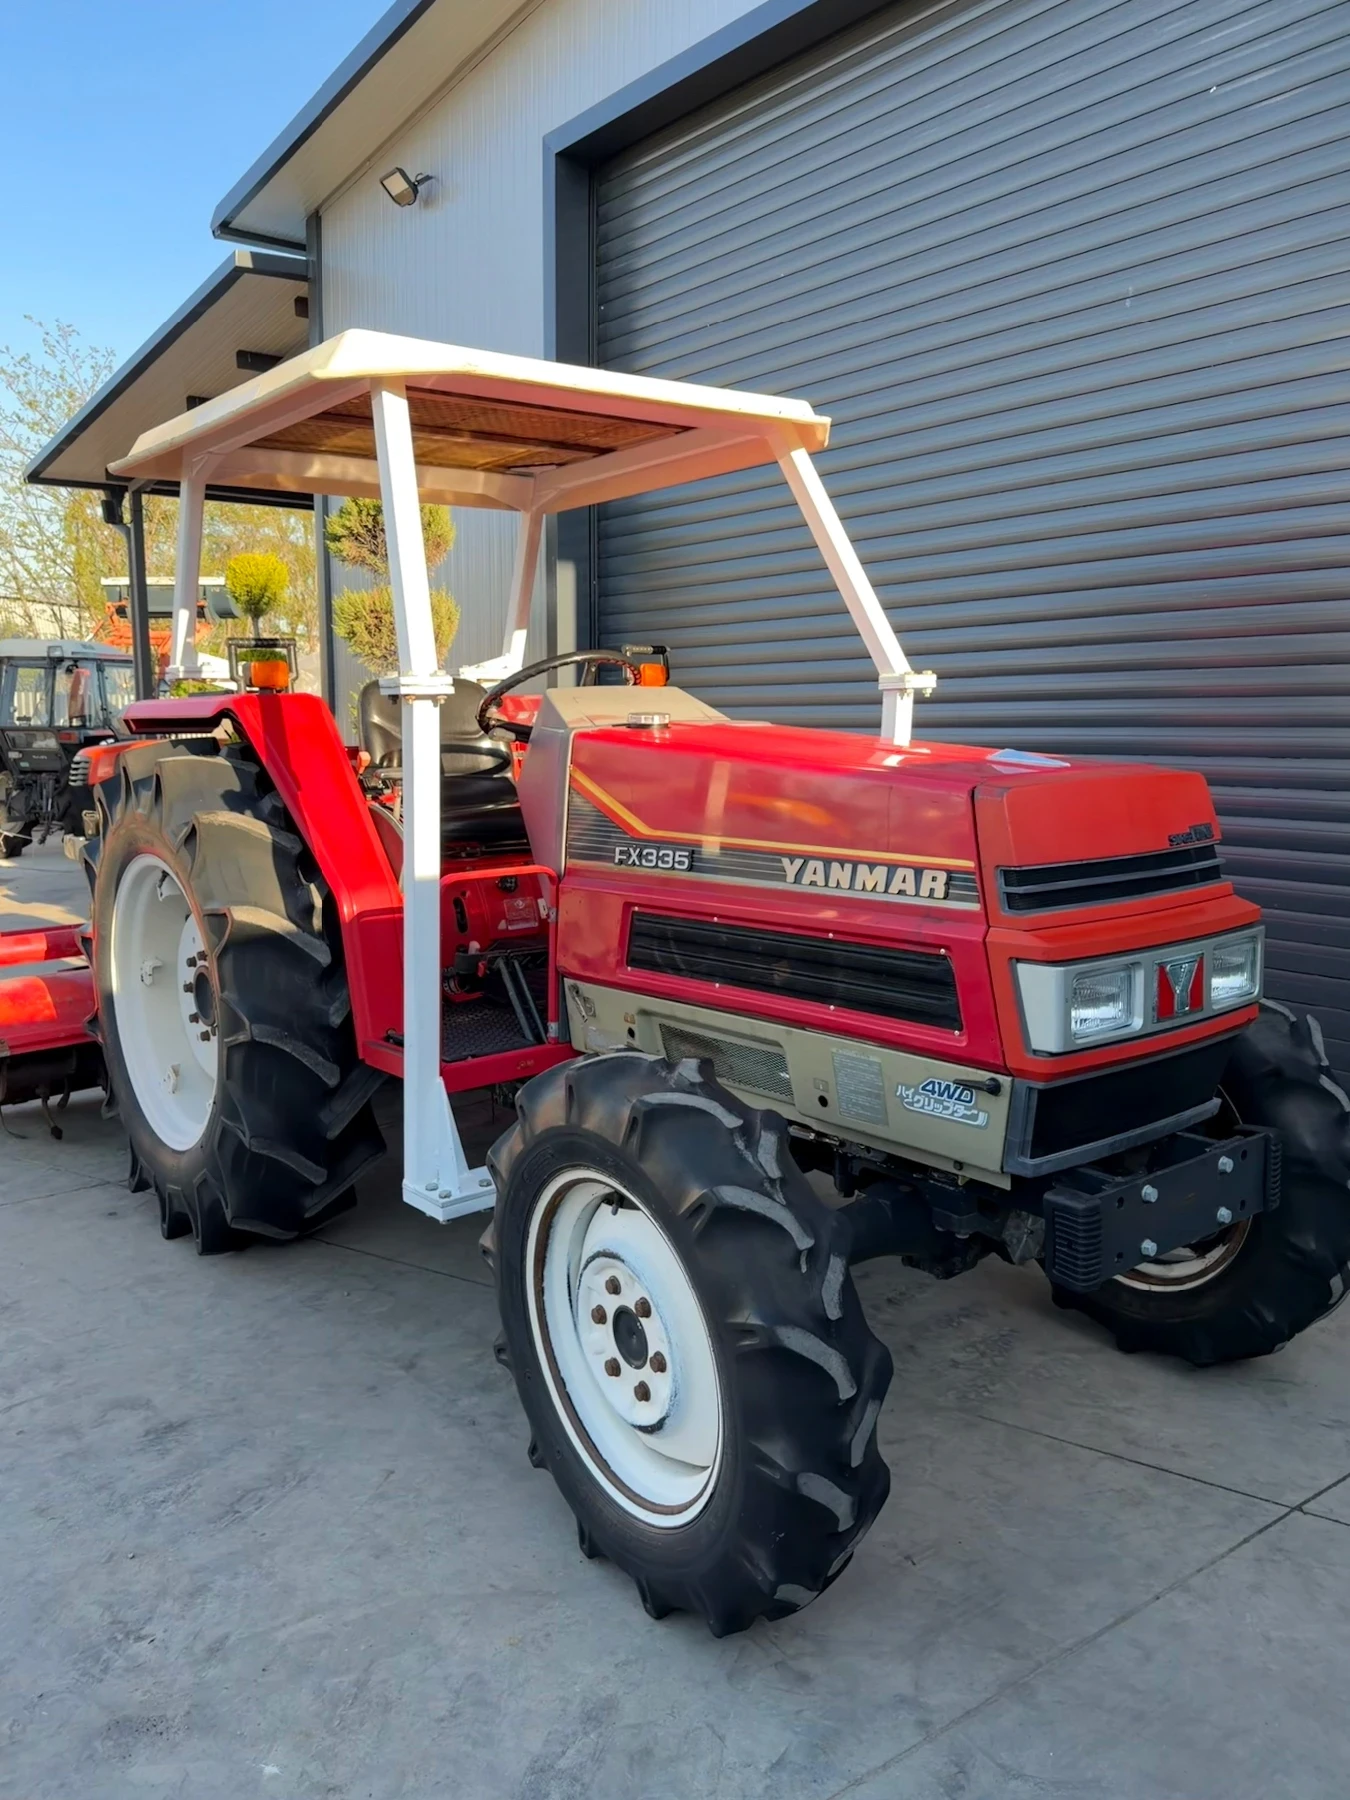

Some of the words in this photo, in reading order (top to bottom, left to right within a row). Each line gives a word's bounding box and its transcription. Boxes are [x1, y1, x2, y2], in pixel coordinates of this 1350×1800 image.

[614, 845, 690, 870] FX335
[781, 857, 948, 899] YANMAR
[920, 1079, 975, 1105] 4WD
